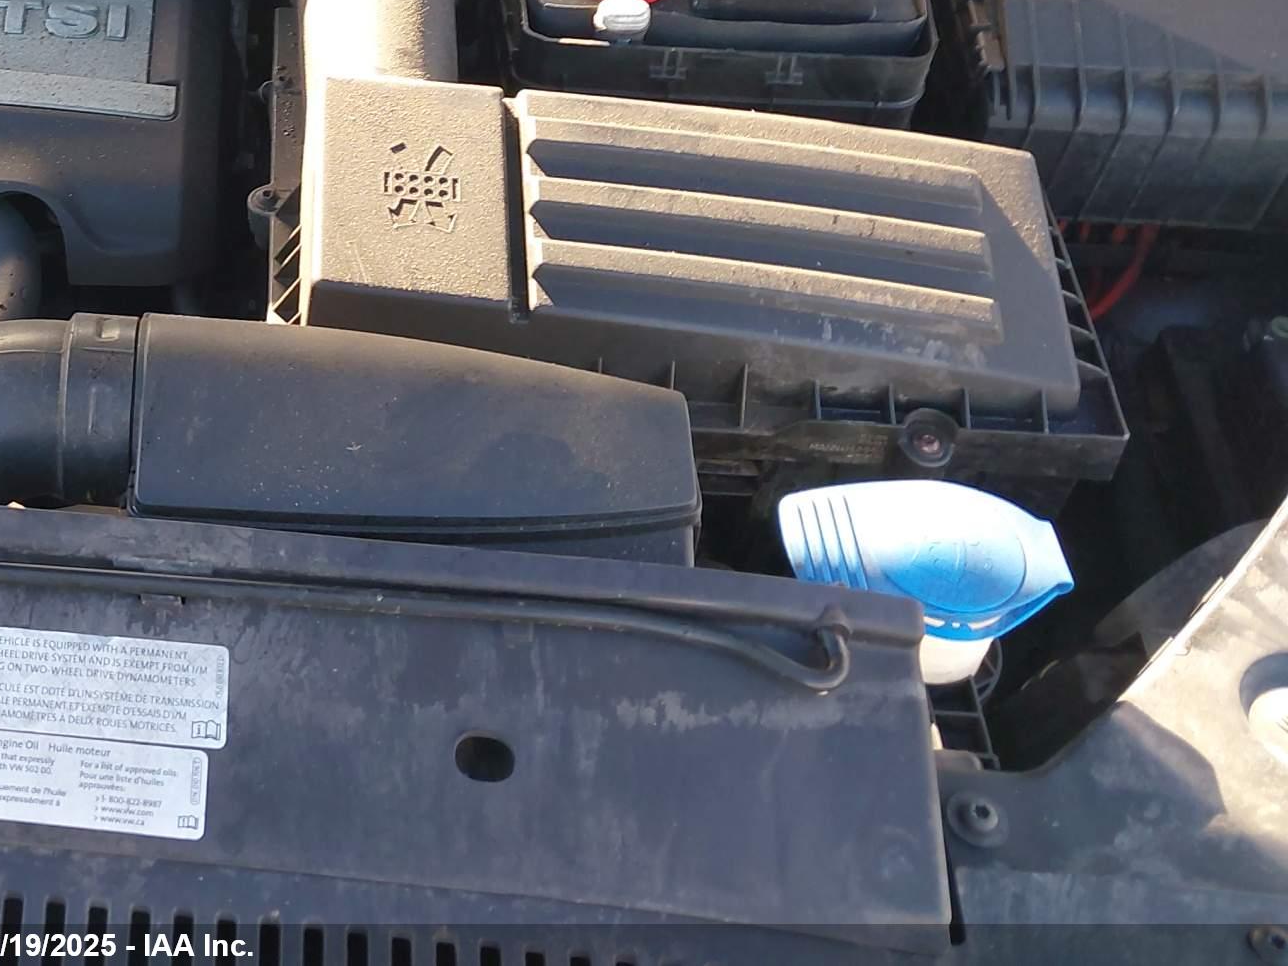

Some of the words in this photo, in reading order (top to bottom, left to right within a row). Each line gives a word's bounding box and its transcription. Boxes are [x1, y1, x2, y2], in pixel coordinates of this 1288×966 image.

[32, 638, 41, 648] IS
[43, 639, 91, 654] EQUIPPED
[92, 643, 118, 655] WITH
[120, 646, 128, 656] A
[129, 646, 188, 661] PERMANENT
[21, 650, 49, 662] DRIVE
[51, 652, 87, 665] SYSTEM
[88, 656, 111, 667] AND
[112, 658, 121, 668] IS
[123, 659, 160, 671] EXEMPT
[162, 662, 190, 674] FROM
[7, 661, 23, 672] ON
[25, 663, 84, 677] TWO-WHEEL
[86, 668, 115, 680] DRIVE
[117, 671, 197, 687] DYNAMOMETERS
[12, 696, 67, 711] PERMANENT
[23, 684, 40, 695] EST
[135, 693, 148, 704] DE
[150, 695, 220, 710] TRANSMISSION
[67, 714, 94, 726] DEUX
[24, 740, 39, 750] Oil
[48, 742, 73, 754] Huile
[75, 745, 112, 758] moteur
[1, 751, 18, 761] that
[19, 753, 55, 766] expressly
[9, 763, 24, 772] VW
[80, 759, 93, 769] For
[94, 761, 100, 769] a
[101, 761, 113, 770] list
[114, 762, 123, 771] of
[124, 764, 161, 777] approved
[79, 770, 97, 780] Pour
[99, 772, 114, 782] une
[115, 774, 133, 783] liste
[31, 785, 42, 794] de
